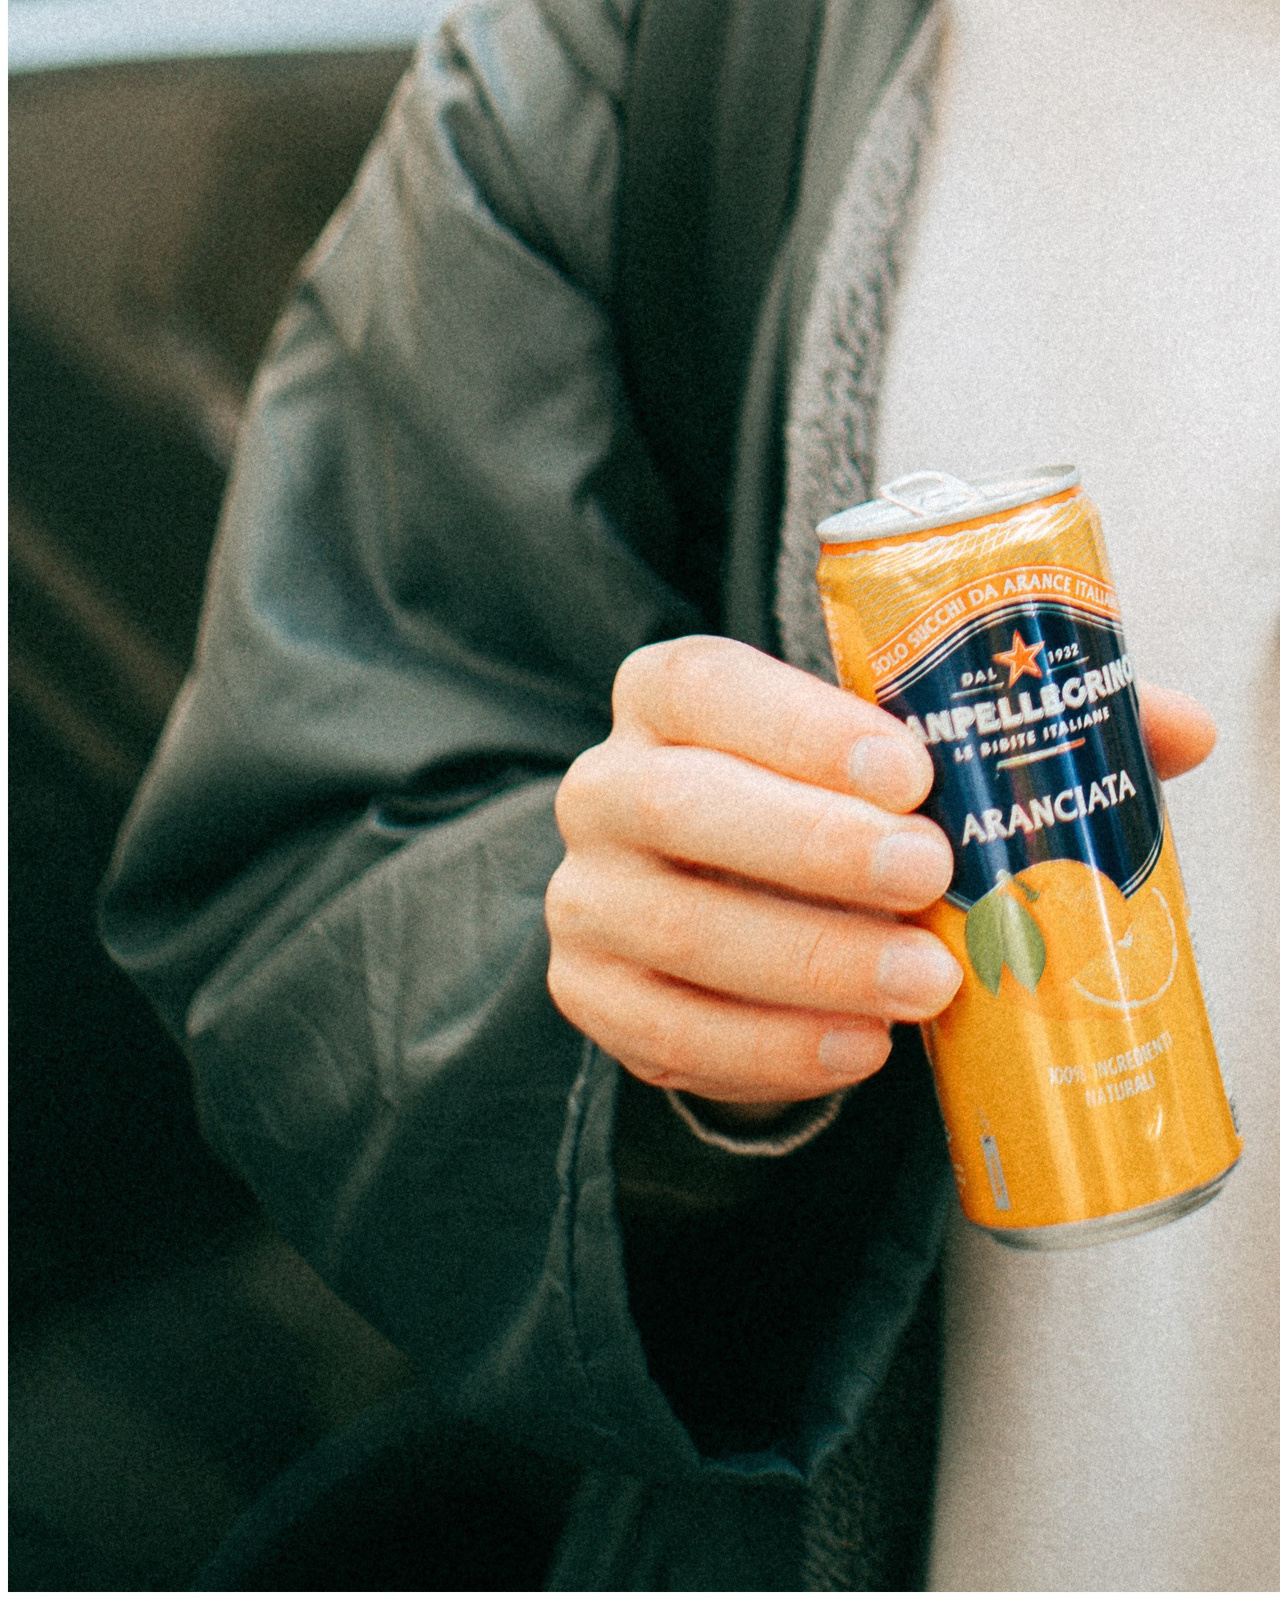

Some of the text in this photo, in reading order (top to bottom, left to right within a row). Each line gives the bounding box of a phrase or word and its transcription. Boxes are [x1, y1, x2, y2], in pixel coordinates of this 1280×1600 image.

[871, 642, 909, 677] SOLO
[907, 596, 967, 647] SUCCHI
[968, 581, 999, 607] DA
[1002, 572, 1073, 596] ARANCE
[960, 642, 1080, 688] DAL 1932
[905, 653, 1134, 746] ANPELLEGRINO
[954, 706, 1110, 764] LE BIBITE ITALIANE
[962, 769, 1137, 847] ARANCIATA
[1048, 1030, 1174, 1086] 100% INGREDIENTI
[1085, 1069, 1156, 1107] NATURALI
